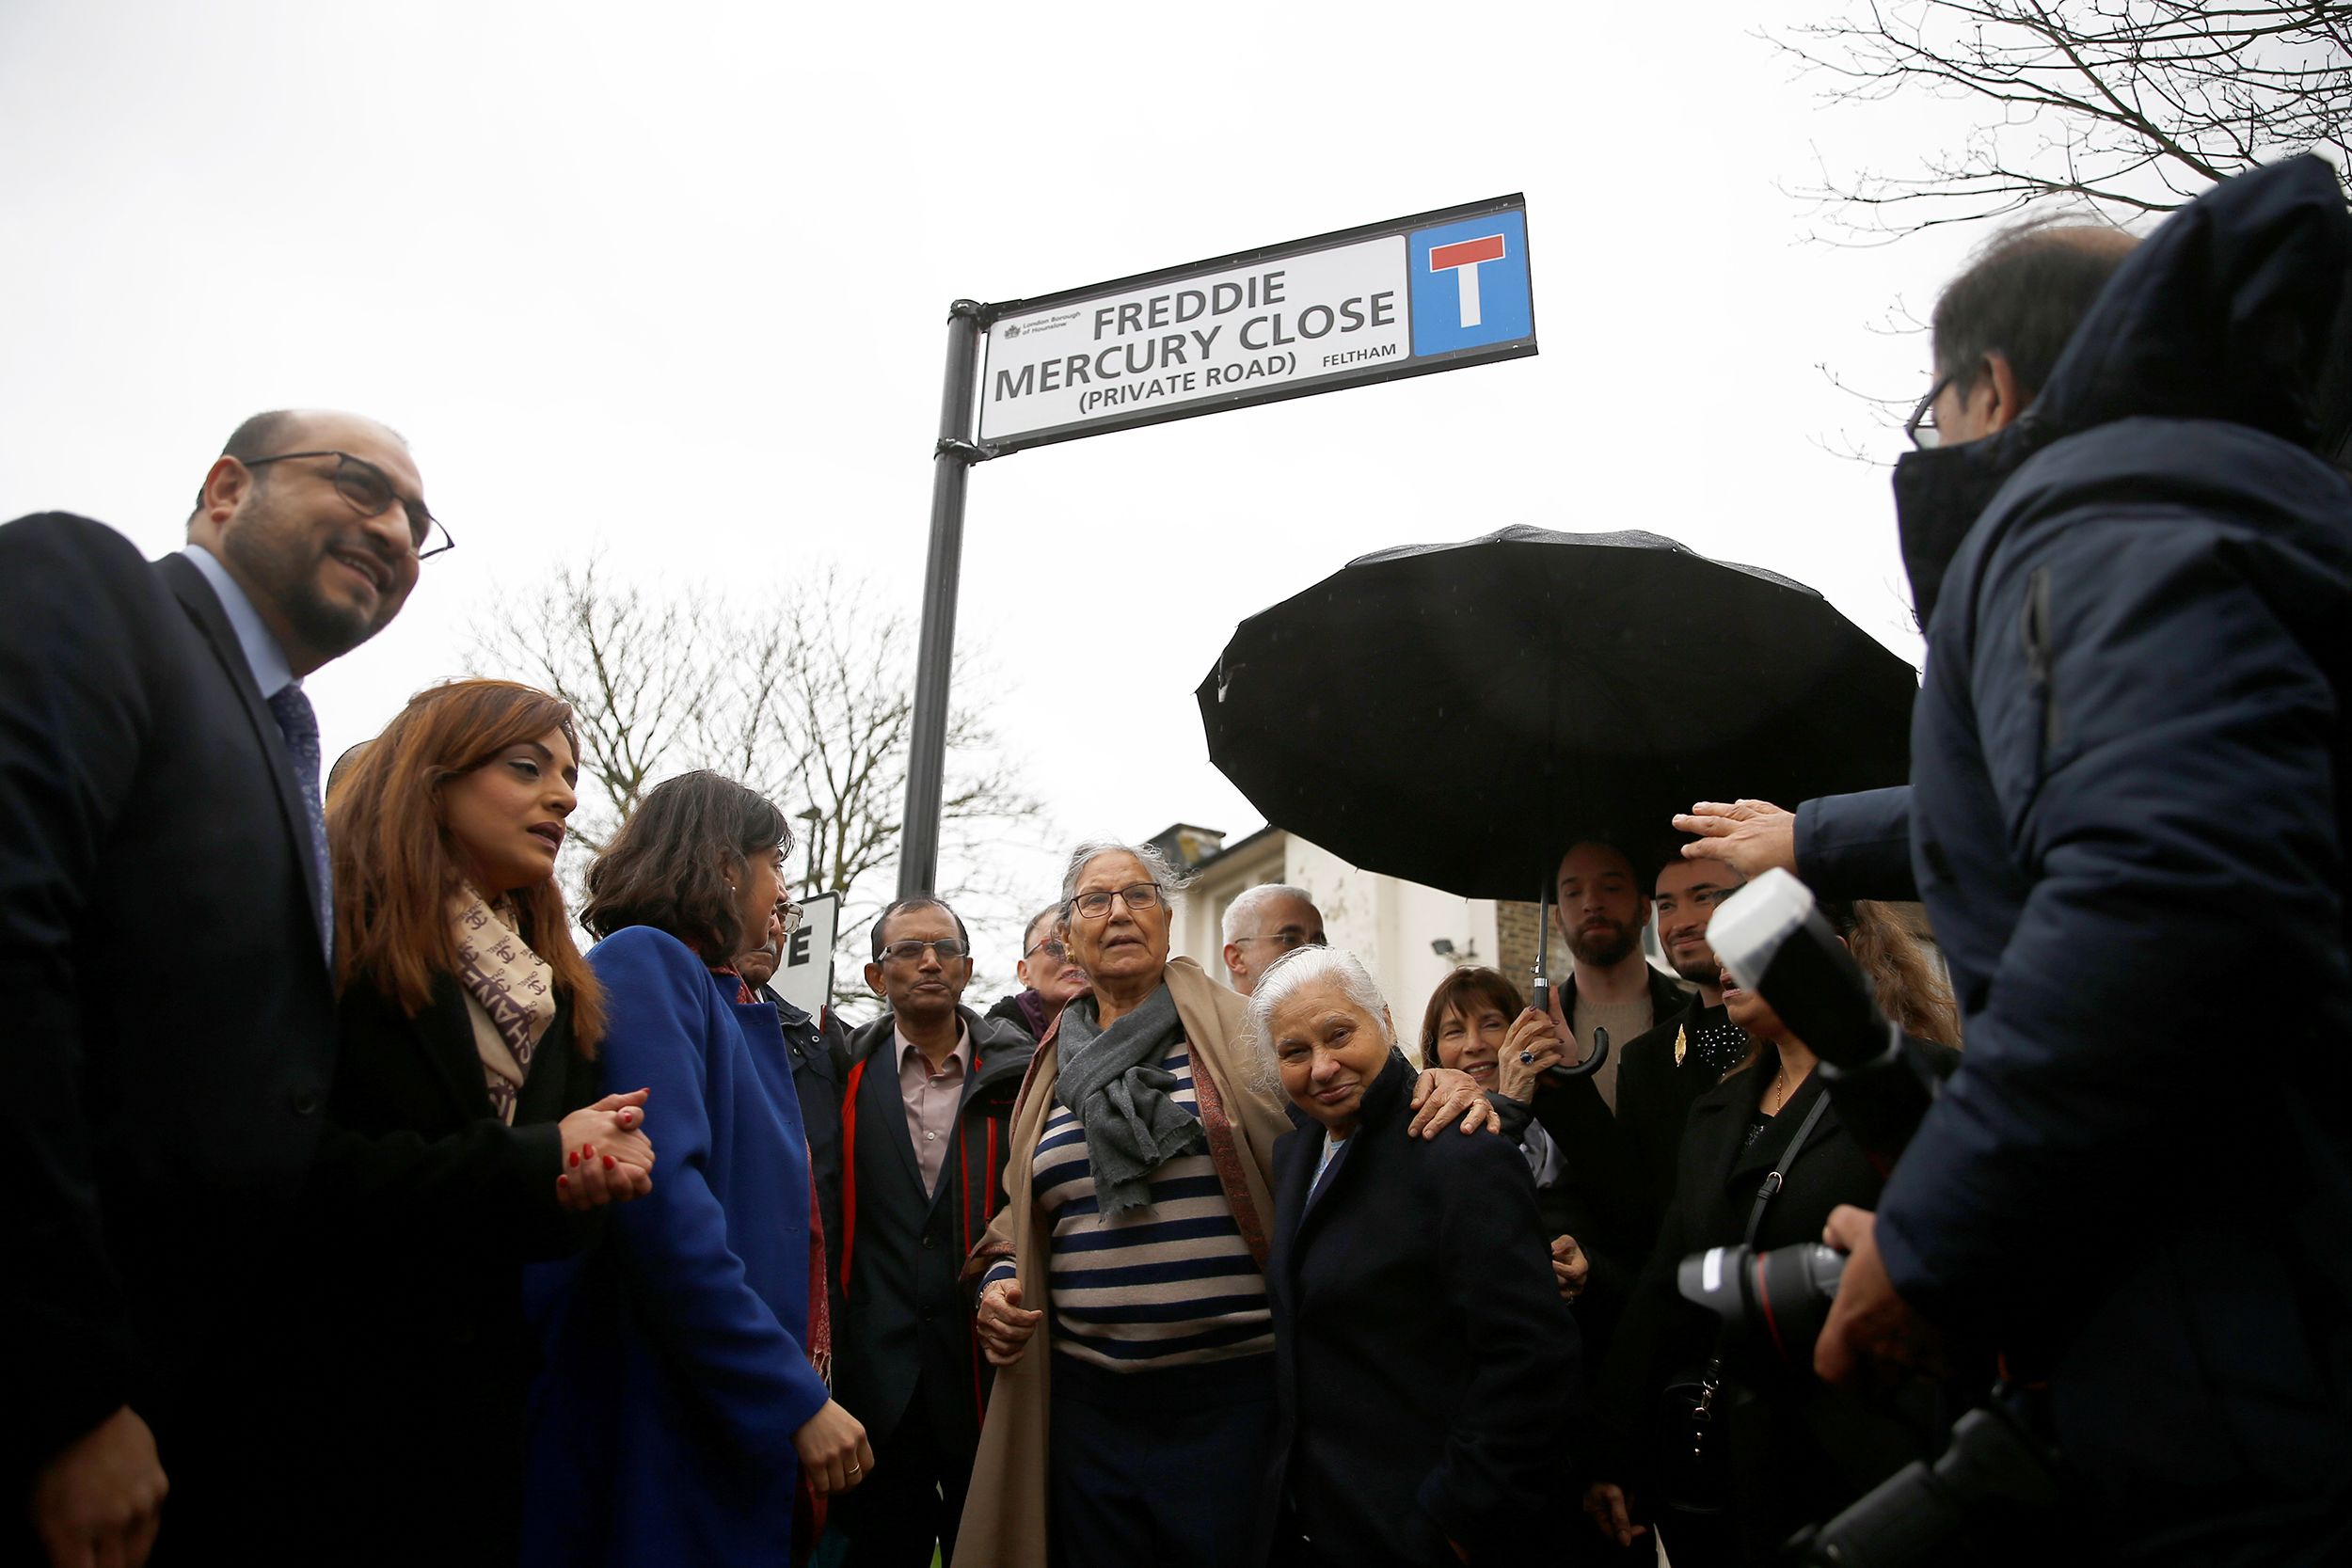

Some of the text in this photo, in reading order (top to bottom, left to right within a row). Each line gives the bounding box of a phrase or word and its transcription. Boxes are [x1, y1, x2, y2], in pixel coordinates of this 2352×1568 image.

[1023, 311, 1081, 329] London Borough
[1093, 271, 1286, 341] FREDDIE
[1031, 322, 1067, 333] Hounslow
[994, 290, 1395, 403] MERCURY CLOSE
[1323, 343, 1396, 368] FELTHAM
[1079, 351, 1296, 415] (PRIVATE ROAD)
[485, 935, 511, 954] CHANEL
[784, 925, 812, 968] E
